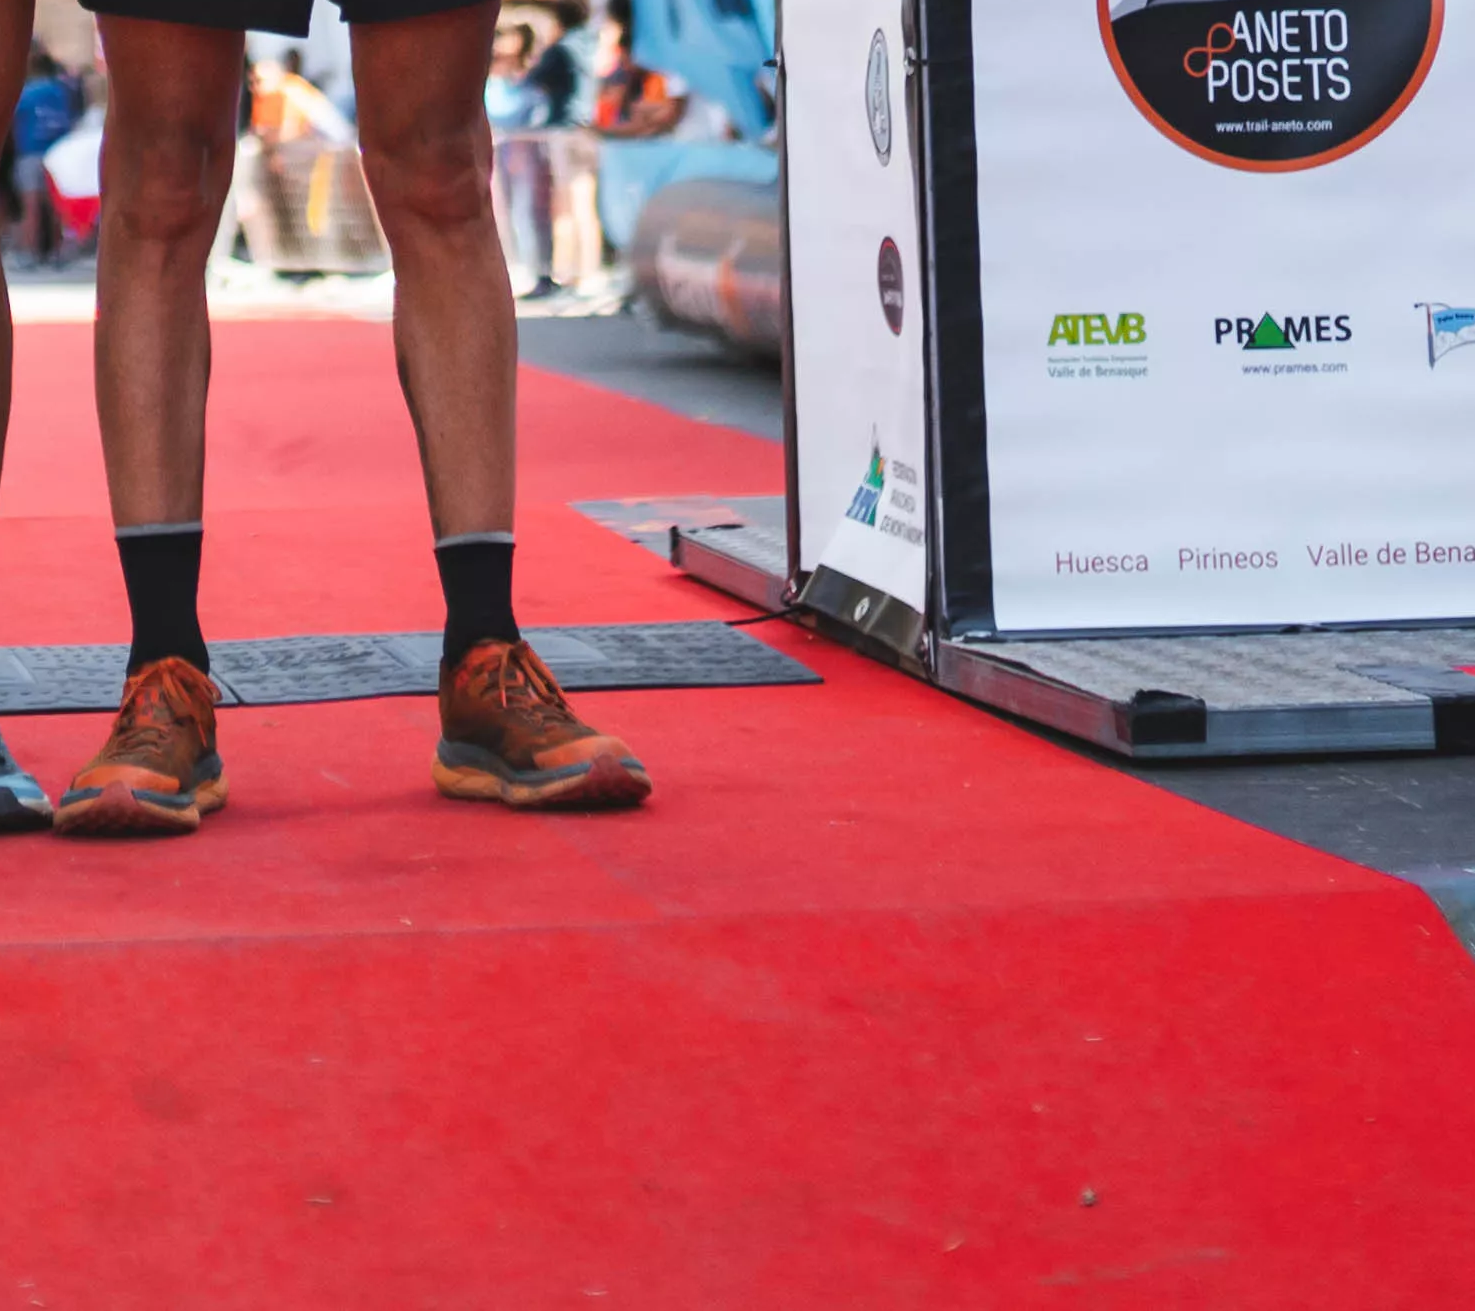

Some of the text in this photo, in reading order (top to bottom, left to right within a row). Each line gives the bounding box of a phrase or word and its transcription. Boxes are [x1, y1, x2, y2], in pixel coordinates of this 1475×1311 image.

[1230, 8, 1349, 54] ANETO
[1206, 55, 1353, 104] POSETS
[1215, 118, 1333, 134] www.trail-aneto.com
[1214, 311, 1353, 350] PRAMES
[1079, 365, 1091, 377] de
[1242, 361, 1349, 376] www.prames.com
[1055, 550, 1149, 574] Huesca
[1178, 546, 1278, 571] Pirineos
[1306, 544, 1369, 568] Valle
[1375, 543, 1407, 566] de
